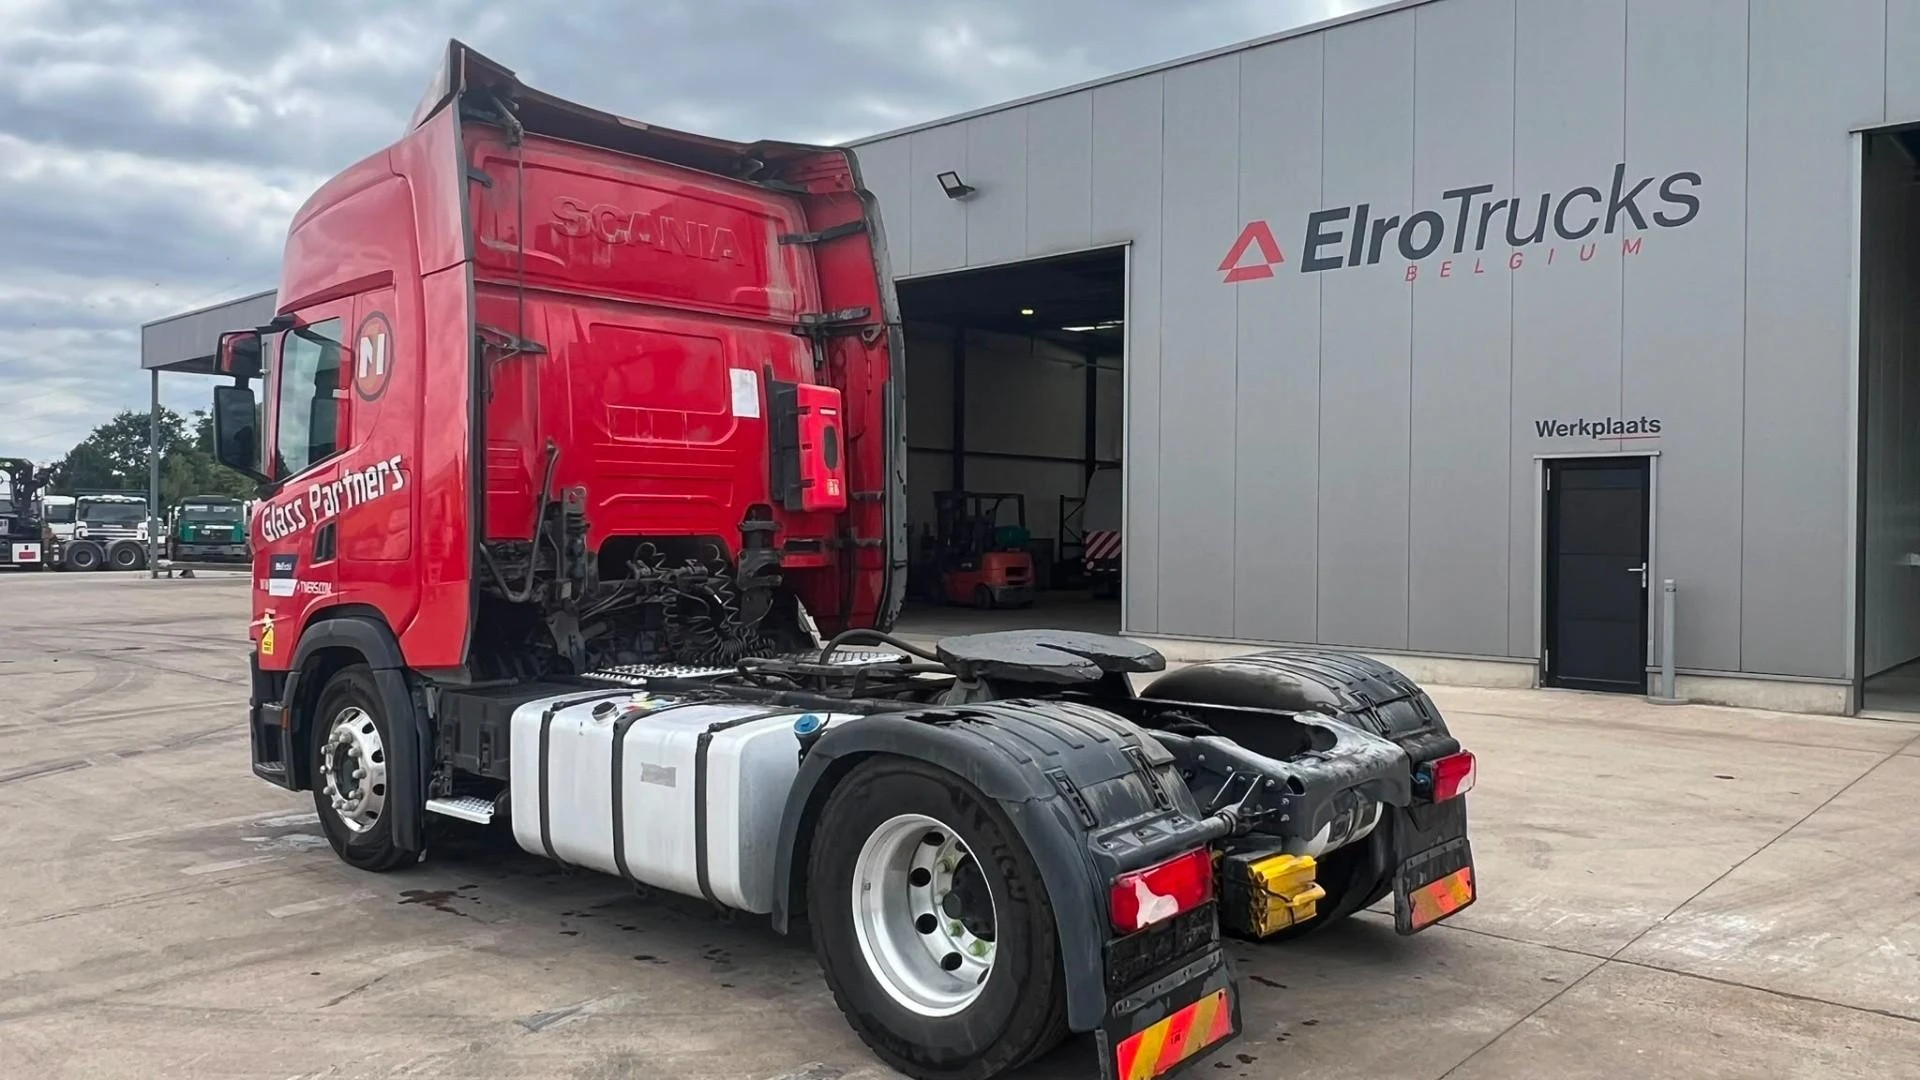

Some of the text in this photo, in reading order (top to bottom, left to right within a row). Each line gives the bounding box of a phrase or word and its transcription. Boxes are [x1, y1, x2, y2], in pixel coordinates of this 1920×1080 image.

[552, 196, 745, 266] SCANIA
[1301, 163, 1702, 273] ElroTrucks
[1404, 238, 1642, 282] BELGIUM
[1535, 416, 1661, 439] Werkplaats
[262, 455, 406, 543] Glass Partners
